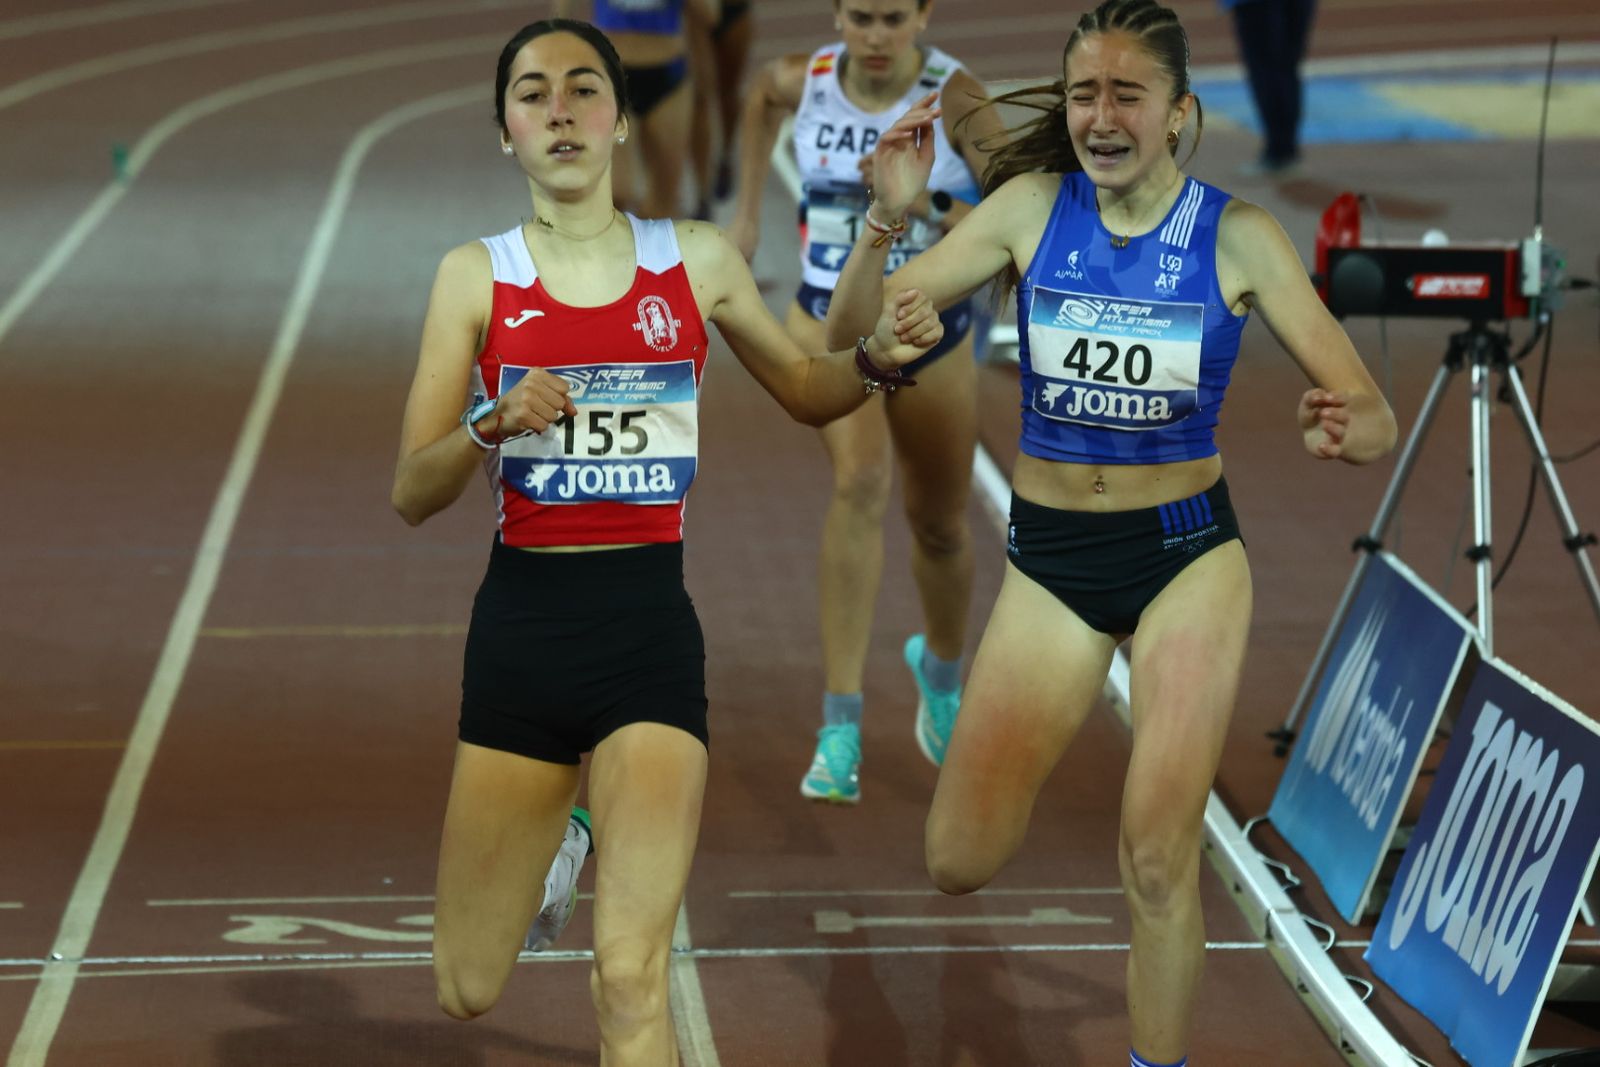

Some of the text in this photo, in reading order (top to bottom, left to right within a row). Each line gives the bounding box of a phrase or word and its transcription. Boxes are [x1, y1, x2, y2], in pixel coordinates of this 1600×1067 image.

[1106, 302, 1153, 317] RFEA
[1100, 313, 1173, 330] ATLETISMO
[1097, 323, 1163, 338] SHORT TRACK
[1063, 337, 1153, 386] 420
[594, 369, 646, 382] RFEA
[590, 380, 667, 391] ATLETISMO
[587, 391, 658, 402] SHORT TRACK
[553, 409, 649, 456] 155
